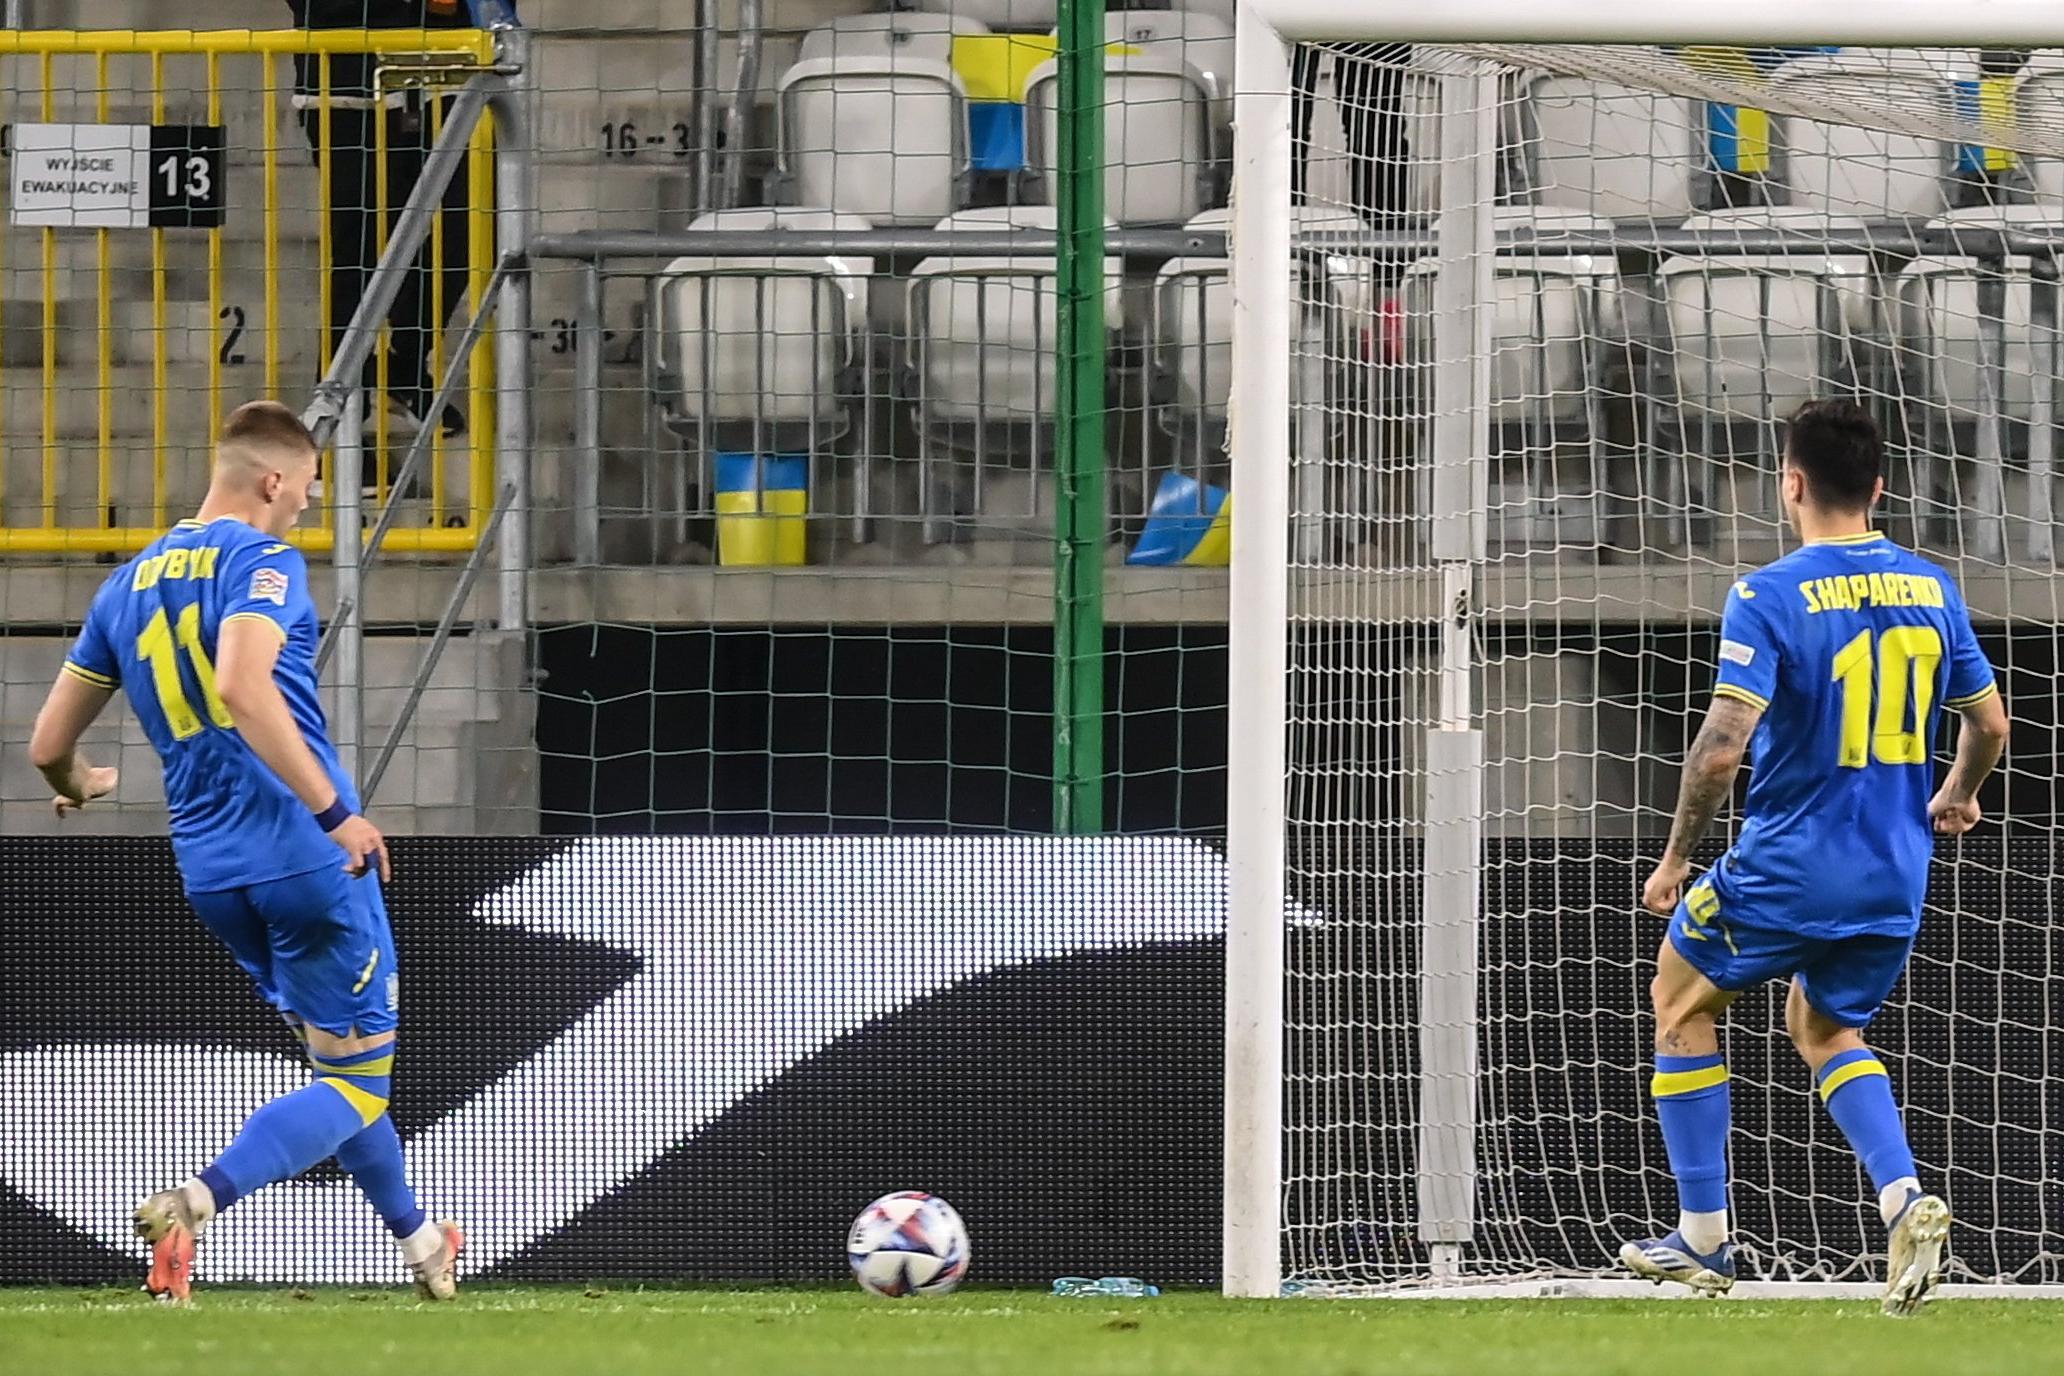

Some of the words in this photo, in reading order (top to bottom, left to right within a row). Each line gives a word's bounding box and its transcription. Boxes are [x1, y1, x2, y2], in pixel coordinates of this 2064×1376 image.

[22, 180, 139, 195] EWAKUACYJNE
[46, 156, 114, 171] WYJŚCIE
[158, 156, 211, 197] 13
[219, 306, 245, 364] 2
[136, 602, 236, 741] 11
[1832, 625, 1942, 768] 10
